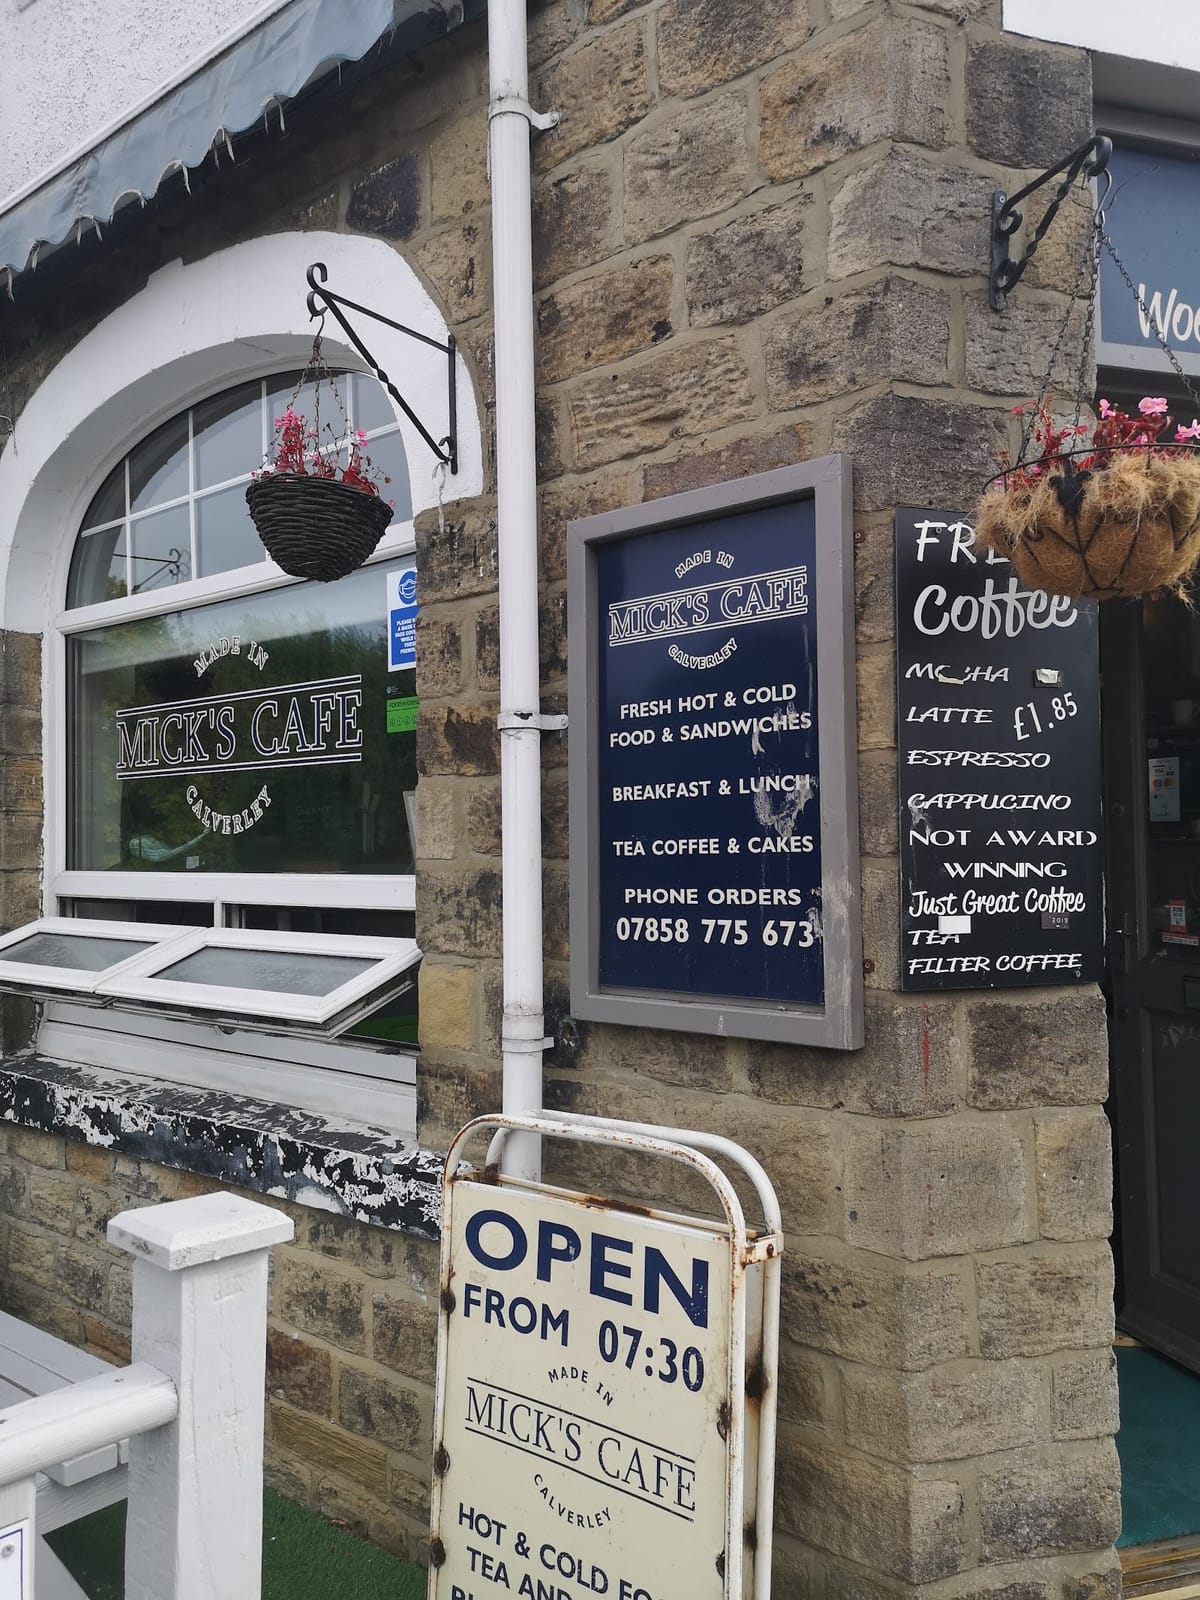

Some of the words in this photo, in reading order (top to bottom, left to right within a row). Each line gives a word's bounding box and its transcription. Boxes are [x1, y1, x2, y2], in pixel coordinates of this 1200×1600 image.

[1137, 283, 1200, 343] Wo
[675, 550, 712, 578] MADE
[716, 551, 735, 569] IN
[609, 592, 710, 640] MICK'S
[720, 576, 809, 620] CAFE
[913, 577, 1078, 639] Coffee
[193, 636, 241, 678] MADE
[249, 640, 269, 671] IN
[668, 638, 738, 670] CALVERLEY
[620, 699, 672, 720] FRESH
[678, 693, 718, 713] HOT
[724, 692, 737, 708] &
[743, 684, 797, 705] COLD
[905, 706, 994, 724] LATTE
[1013, 691, 1079, 741] £1.85
[116, 705, 236, 769] MICK'S
[250, 688, 363, 756] CAFE
[610, 730, 656, 748] FOOD
[661, 727, 674, 743] &
[680, 712, 812, 740] SANDWICHES
[907, 750, 1051, 768] ESPRESSO
[612, 780, 711, 802] BREAKFAST
[718, 780, 732, 796] &
[739, 774, 810, 795] LUNCH
[907, 793, 1072, 811] CAPPUCINO
[185, 784, 272, 835] CALVERLEY
[613, 840, 646, 856] TEA
[651, 838, 720, 855] COFFEE
[727, 837, 740, 854] &
[747, 836, 814, 853] CAKES
[909, 830, 972, 846] NOT
[985, 830, 1098, 846] AWARD
[943, 862, 1068, 878] WINNING
[624, 888, 698, 905] PHONE
[707, 888, 802, 906] ORDERS
[908, 890, 959, 918] Just
[962, 889, 1020, 915] Great
[1025, 885, 1086, 913] Coffee
[616, 917, 689, 943] 07858
[701, 919, 749, 946] 775
[762, 919, 815, 948] 673
[907, 929, 960, 945] TEA
[907, 956, 991, 975] FILTER
[995, 953, 1083, 973] COFFEE
[465, 1209, 710, 1330] OPEN
[463, 1283, 570, 1347] FROM
[598, 1320, 704, 1393] 07:30
[547, 1365, 589, 1383] MADE
[596, 1382, 614, 1408] IN
[465, 1386, 583, 1463] MICK'S
[598, 1437, 696, 1512] CAFE
[533, 1473, 612, 1529] CALVERLEY
[458, 1502, 508, 1546] HOT
[514, 1531, 531, 1560] &
[539, 1543, 609, 1594] COLD
[466, 1545, 511, 1589] TEA
